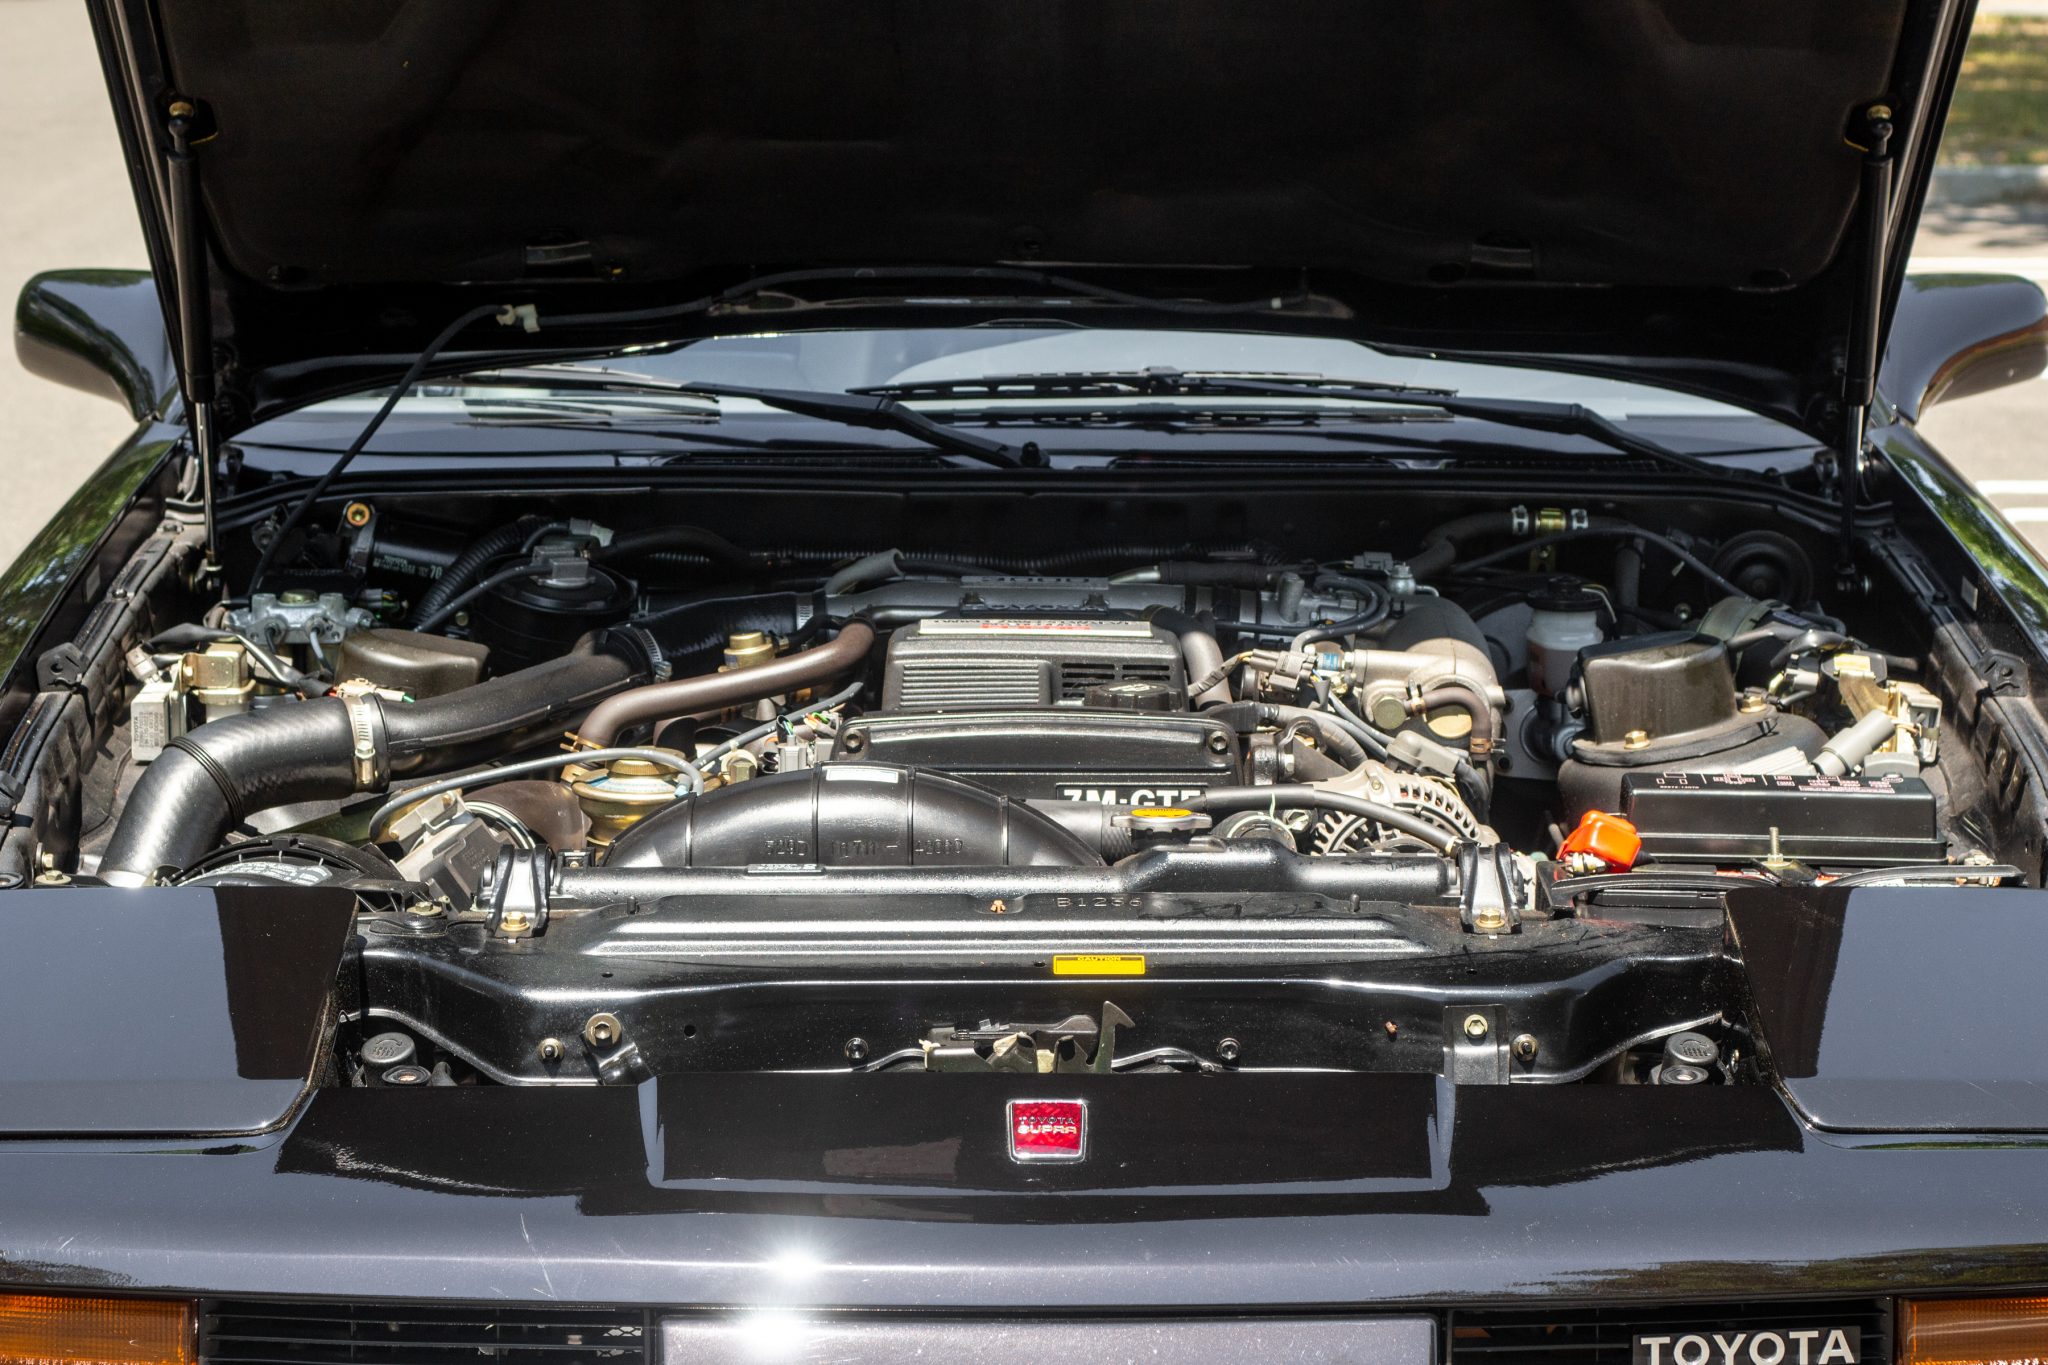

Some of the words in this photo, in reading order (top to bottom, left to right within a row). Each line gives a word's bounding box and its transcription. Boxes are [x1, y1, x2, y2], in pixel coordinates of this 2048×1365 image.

[1018, 1116, 1075, 1125] TOYOTA
[1017, 1124, 1078, 1135] SUPRA
[1640, 1329, 1855, 1365] TOYOTA
